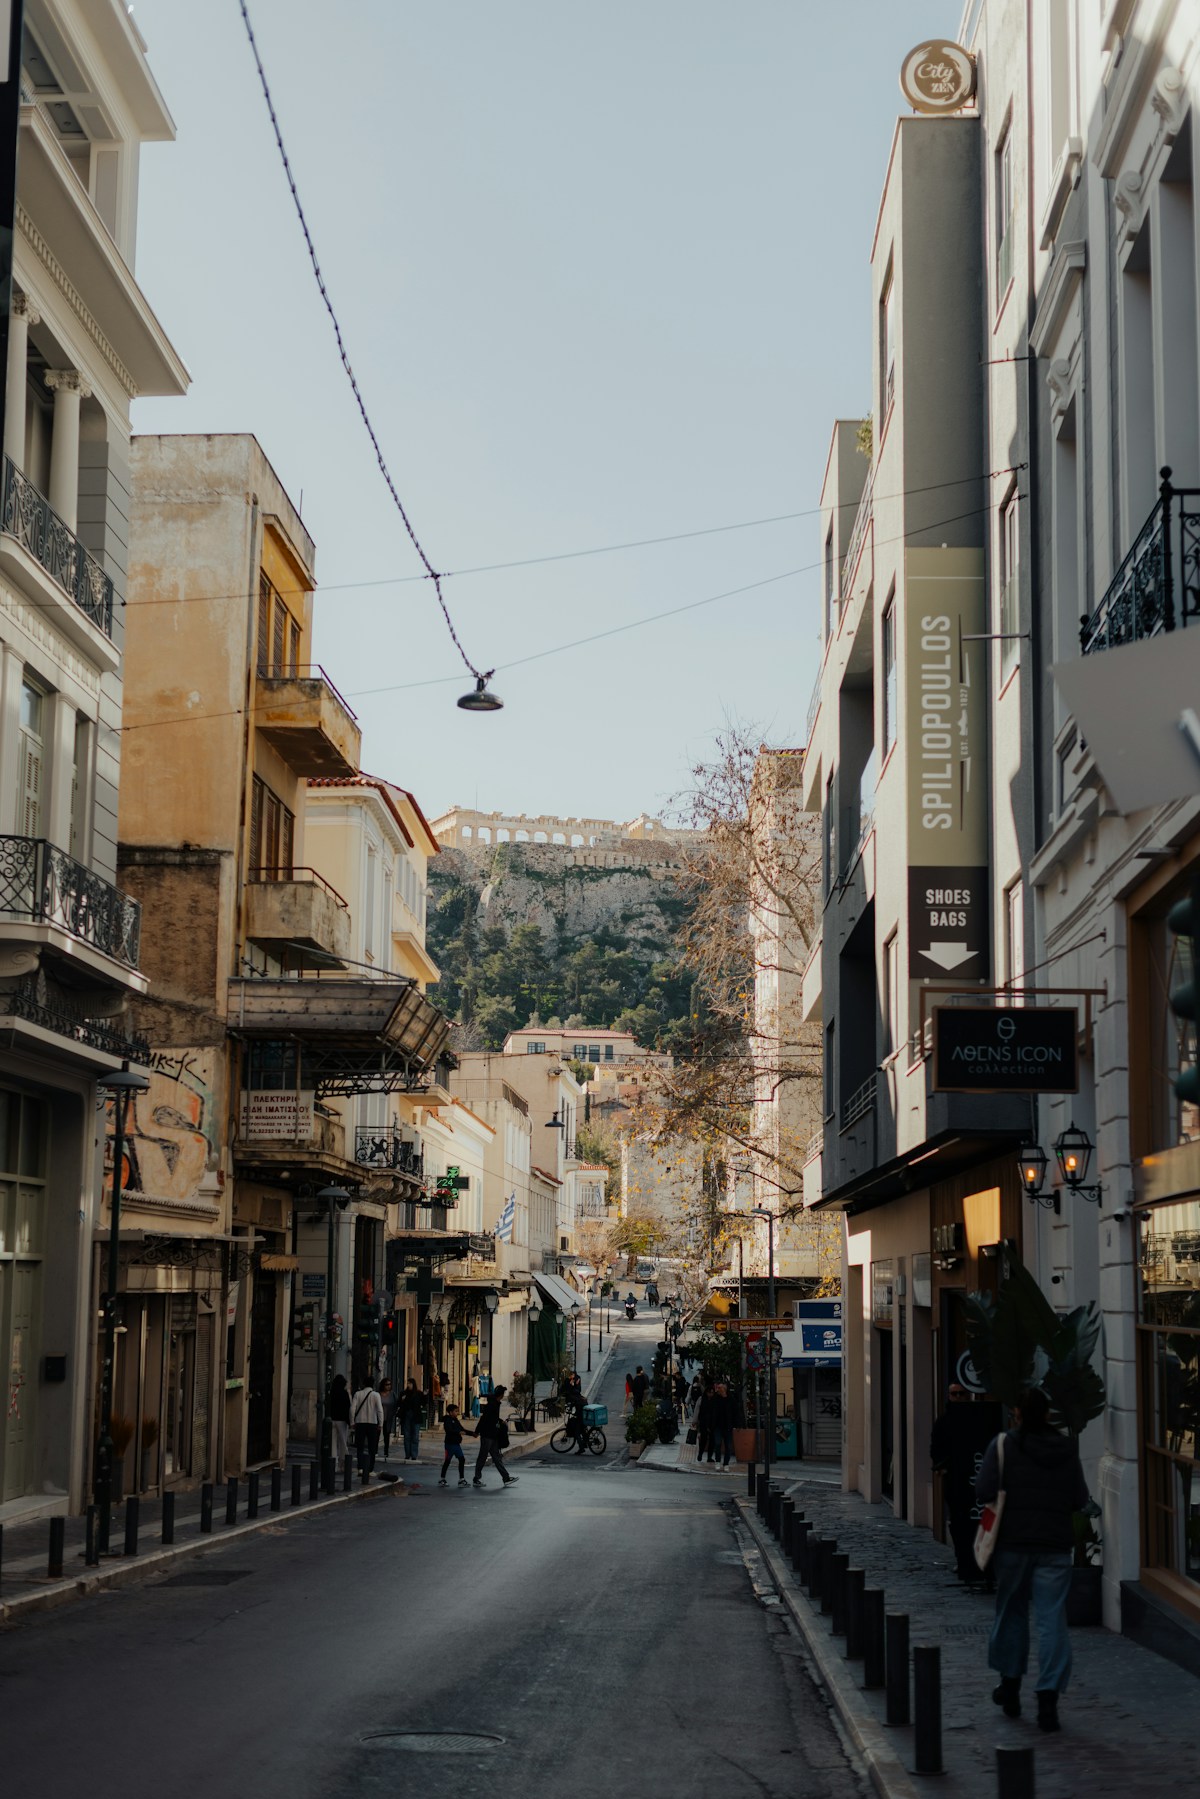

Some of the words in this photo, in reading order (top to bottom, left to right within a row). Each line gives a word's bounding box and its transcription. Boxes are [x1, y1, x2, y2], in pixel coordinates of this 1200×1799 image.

[918, 62, 954, 82] City
[931, 82, 955, 93] ZEN
[921, 615, 953, 829] SPILIOPOULOS
[926, 889, 971, 905] SHOES
[930, 912, 967, 927] BAGS
[1016, 1046, 1062, 1062] ICON
